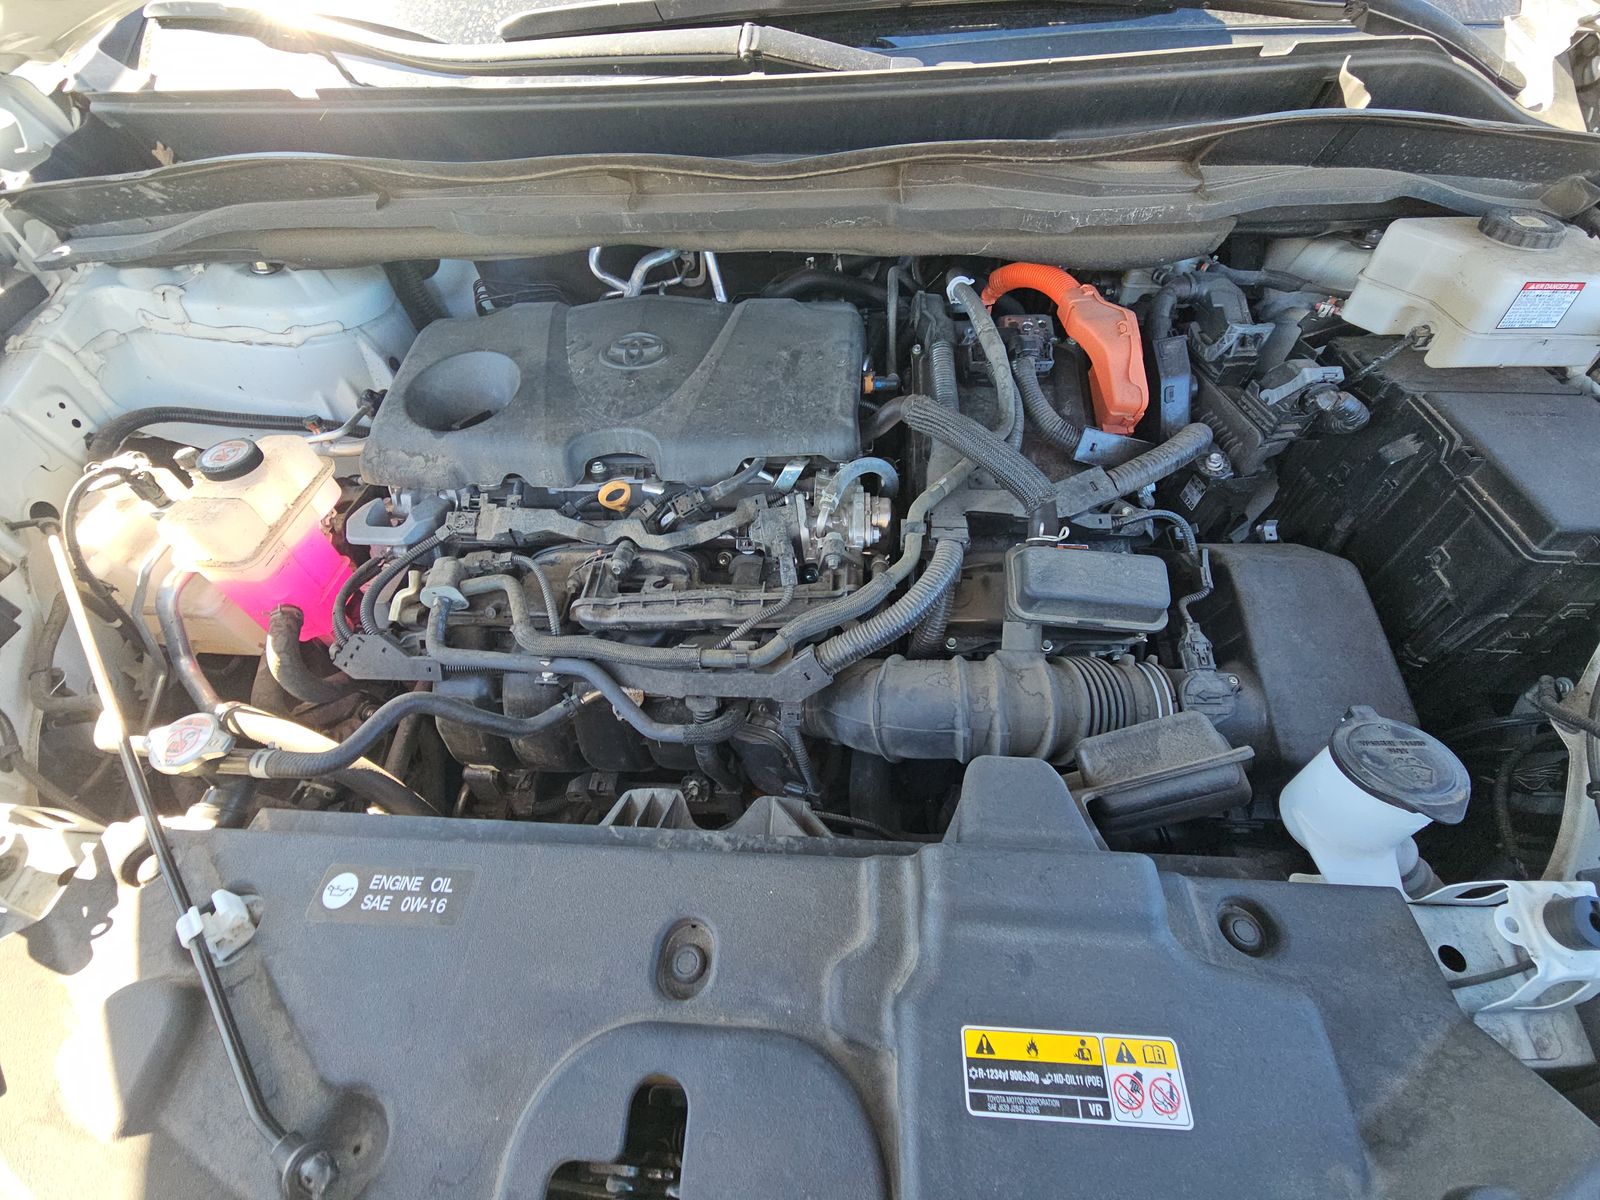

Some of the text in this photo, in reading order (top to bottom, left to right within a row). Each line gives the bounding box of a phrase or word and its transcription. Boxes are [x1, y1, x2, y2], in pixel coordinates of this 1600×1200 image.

[369, 874, 453, 893] ENGINE OIL
[360, 894, 447, 914] SAE 0W-16
[1085, 1075, 1104, 1088] (POE)
[986, 1094, 1060, 1108] TOYOTA MOTOR CORPORATION
[1088, 1103, 1104, 1117] VR
